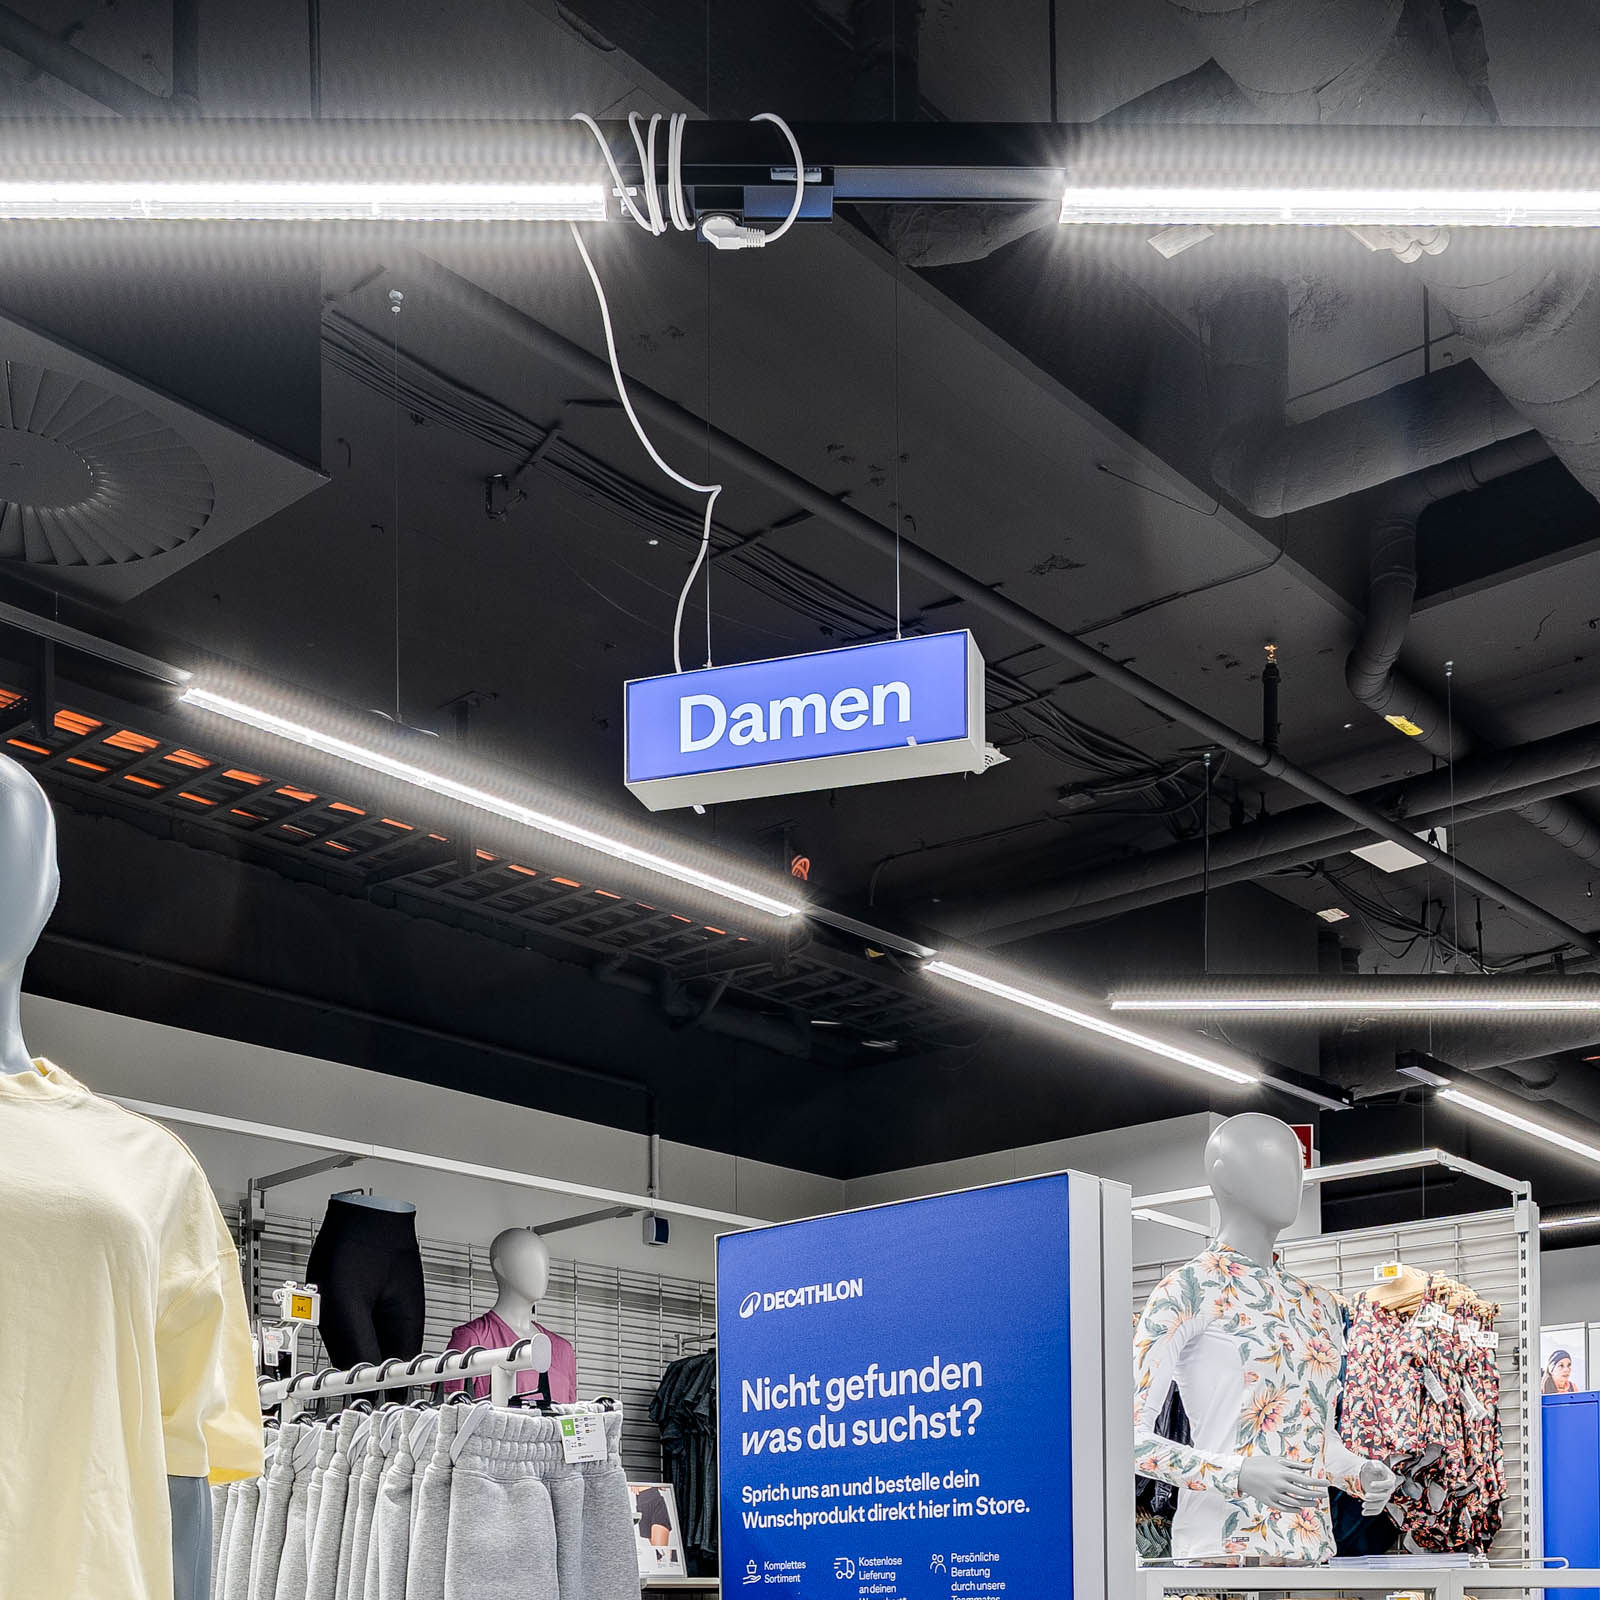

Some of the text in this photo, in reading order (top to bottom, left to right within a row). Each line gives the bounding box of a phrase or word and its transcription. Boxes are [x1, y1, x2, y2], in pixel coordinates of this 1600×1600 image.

[679, 679, 912, 754] Damen
[763, 1277, 863, 1313] DECATHLON
[741, 1355, 983, 1413] Nicht gefunden
[741, 1398, 983, 1456] was du suchst?
[742, 1469, 980, 1508] Sprich uns an und bestelle dein
[742, 1496, 1031, 1530] Wunschprodukt direkt hier im Store.
[858, 1556, 903, 1567] Kostenlose
[950, 1552, 1000, 1564] Persönliche
[763, 1560, 807, 1573] Komplettes
[951, 1566, 991, 1579] Beratung
[764, 1573, 801, 1584] Sortiment
[858, 1570, 896, 1582] Lieferung
[858, 1583, 897, 1594] an deinen
[951, 1581, 1006, 1592] durch unsere
